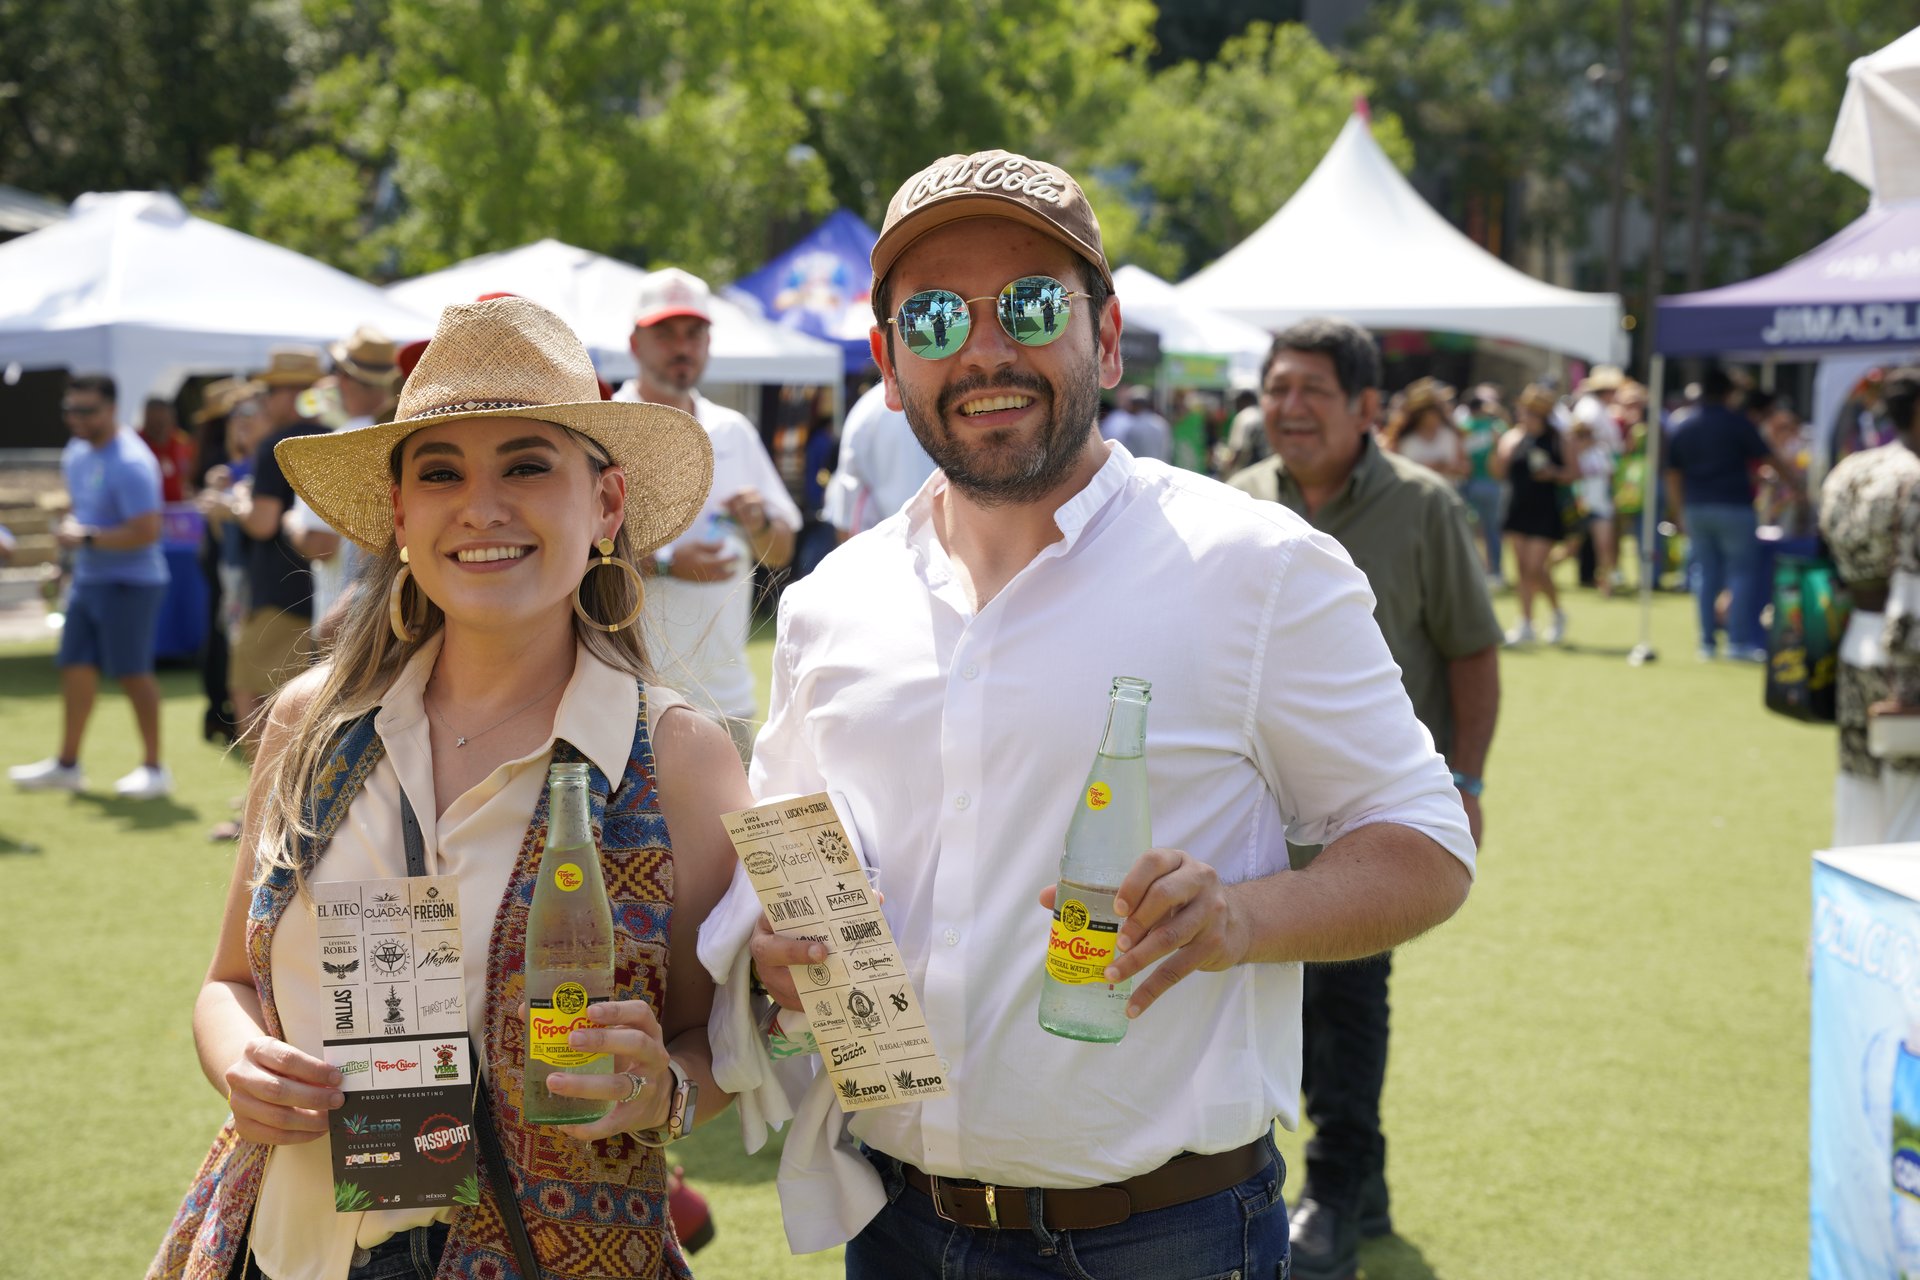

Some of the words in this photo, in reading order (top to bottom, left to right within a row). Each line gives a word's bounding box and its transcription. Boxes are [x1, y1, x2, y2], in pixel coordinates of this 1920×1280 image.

[1761, 304, 1920, 344] JIMADL
[785, 807, 805, 819] LUCKY
[810, 802, 829, 813] STASH
[730, 827, 745, 835] DON
[747, 819, 780, 831] ROBERTO
[781, 848, 817, 867] Kateri
[557, 870, 577, 880] Topo
[563, 877, 581, 887] Chico
[777, 891, 792, 899] TEQUILA
[828, 892, 865, 907] MARFA
[317, 904, 329, 918] EL
[332, 903, 360, 917] ATEO
[364, 907, 412, 918] CUADRA
[767, 901, 787, 923] SAN
[783, 896, 815, 919] MATIAS
[840, 920, 882, 942] CAZADORES
[323, 946, 358, 955] ROBLES
[1068, 936, 1111, 960] Chico
[853, 960, 868, 970] Don
[1070, 963, 1090, 974] WATER
[334, 989, 354, 1029] DALLAS
[533, 1017, 568, 1039] Topo
[826, 1018, 846, 1027] PINEDA
[879, 1043, 902, 1052] ILEGAL
[903, 1037, 930, 1048] MEZCAL
[831, 1041, 867, 1067] Sazón
[374, 1061, 397, 1072] Topo
[395, 1059, 419, 1071] Chico
[434, 1064, 458, 1074] VERDE
[916, 1076, 942, 1088] EXPO
[860, 1084, 887, 1096] EXPO
[370, 1123, 401, 1133] EXPO
[413, 1124, 471, 1153] PASSPORT
[345, 1152, 401, 1166] ZACATECAS
